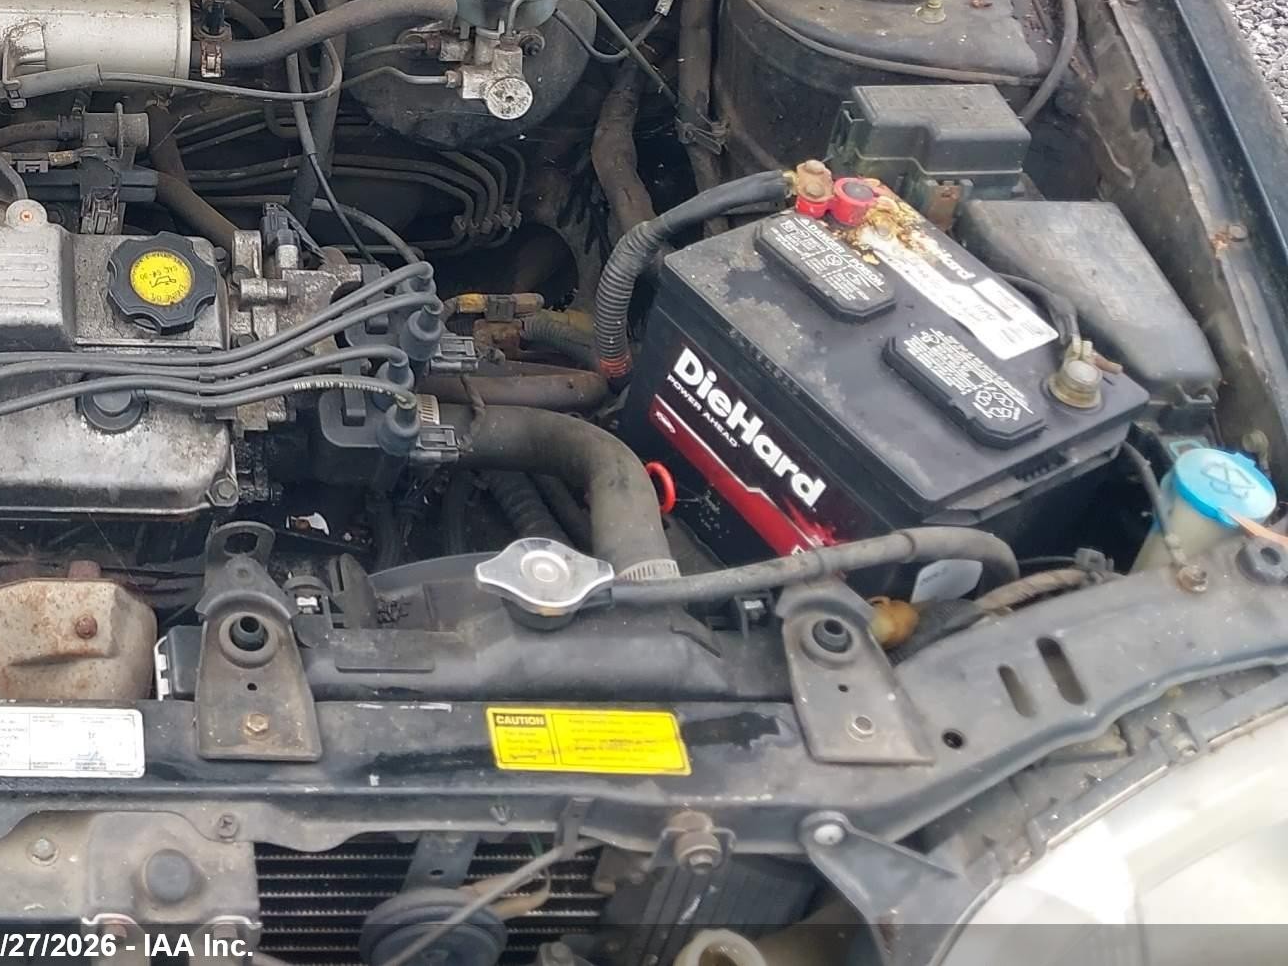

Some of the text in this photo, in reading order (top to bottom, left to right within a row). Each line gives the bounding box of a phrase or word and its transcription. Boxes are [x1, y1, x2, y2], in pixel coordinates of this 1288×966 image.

[808, 224, 846, 253] DANGER
[848, 257, 885, 286] POISON
[293, 381, 312, 391] HIGH
[315, 380, 336, 390] HEAT
[666, 374, 738, 448] POWER AHEAD
[673, 346, 828, 509] DieHard
[495, 714, 545, 726] CAUTION
